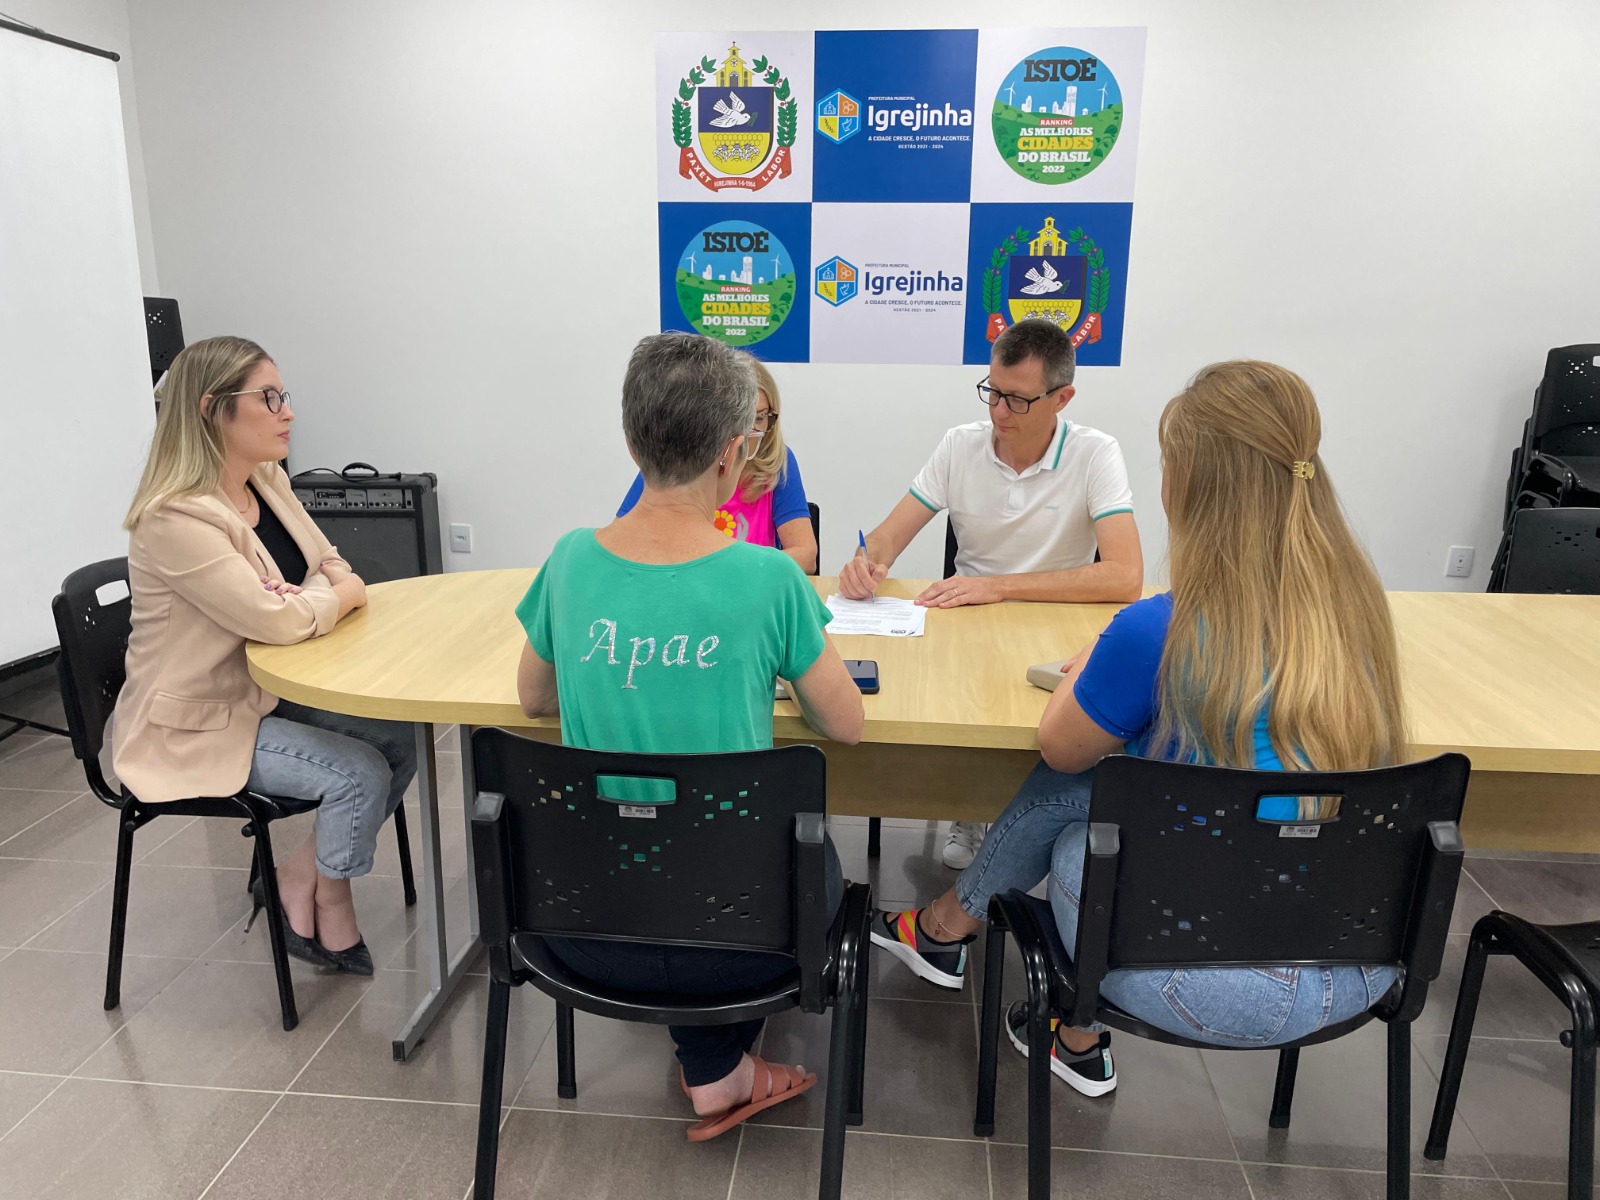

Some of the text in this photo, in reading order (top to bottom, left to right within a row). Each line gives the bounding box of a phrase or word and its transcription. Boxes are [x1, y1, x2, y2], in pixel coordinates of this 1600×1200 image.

[1023, 57, 1098, 82] ISTOÉ
[868, 103, 972, 132] Igrejinha
[1020, 127, 1093, 136] AS MELHORES
[1017, 136, 1094, 150] CIDADES
[1017, 152, 1091, 162] DO BRASIL
[762, 149, 786, 182] LABOR
[1042, 165, 1065, 173] 2022
[714, 180, 738, 188] IGREJINHA
[702, 231, 769, 252] ISTOÉ
[865, 270, 963, 295] Igrejinha
[716, 294, 769, 302] MELHORES
[701, 302, 771, 315] CIDADES
[702, 315, 770, 326] DO BRASIL
[725, 328, 746, 336] 2022
[580, 618, 720, 689] Apae
